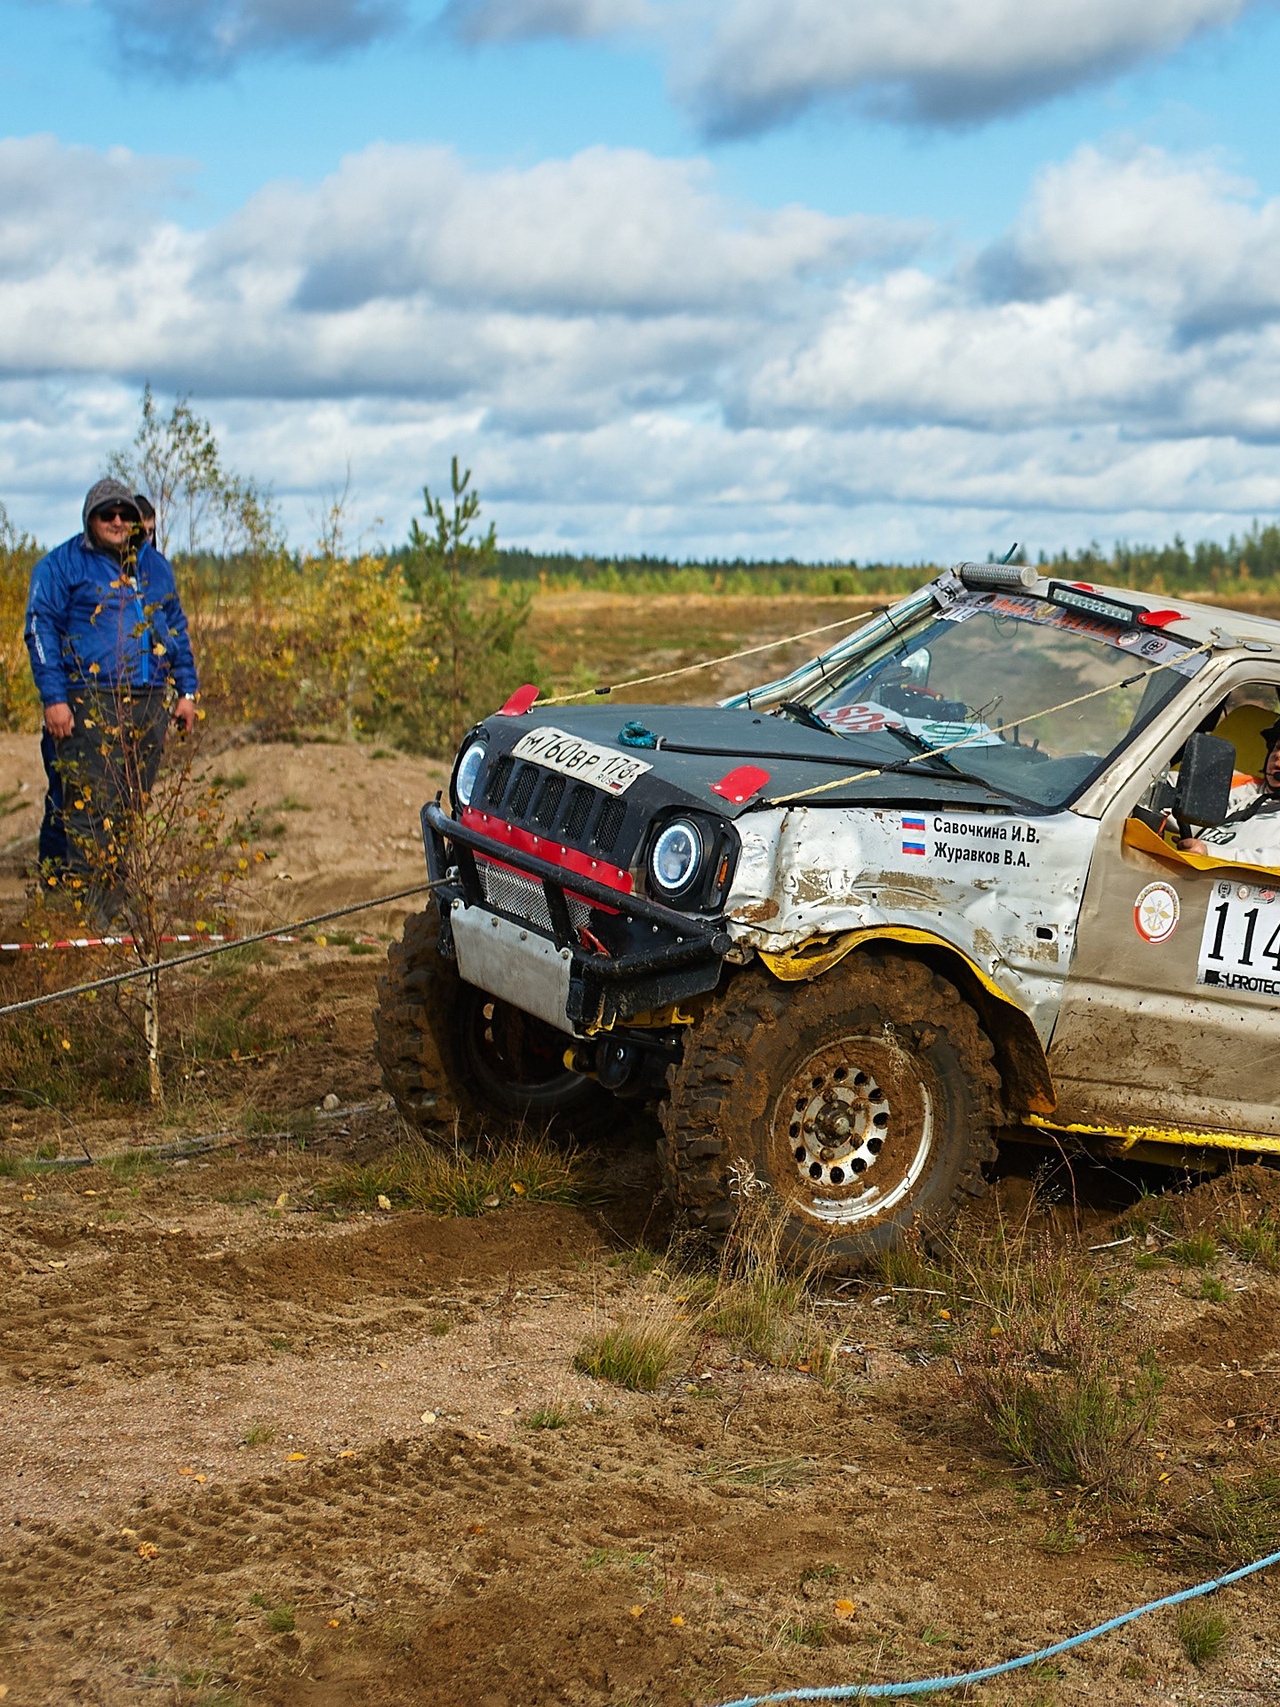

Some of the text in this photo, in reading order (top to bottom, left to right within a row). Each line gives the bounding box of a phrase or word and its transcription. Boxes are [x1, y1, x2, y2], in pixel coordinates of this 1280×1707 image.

[595, 773, 612, 785] RUS
[933, 817, 1040, 844] Савочкина И.В.
[934, 841, 1030, 868] Журавков В.А.
[1217, 971, 1280, 995] SUPROTEC
